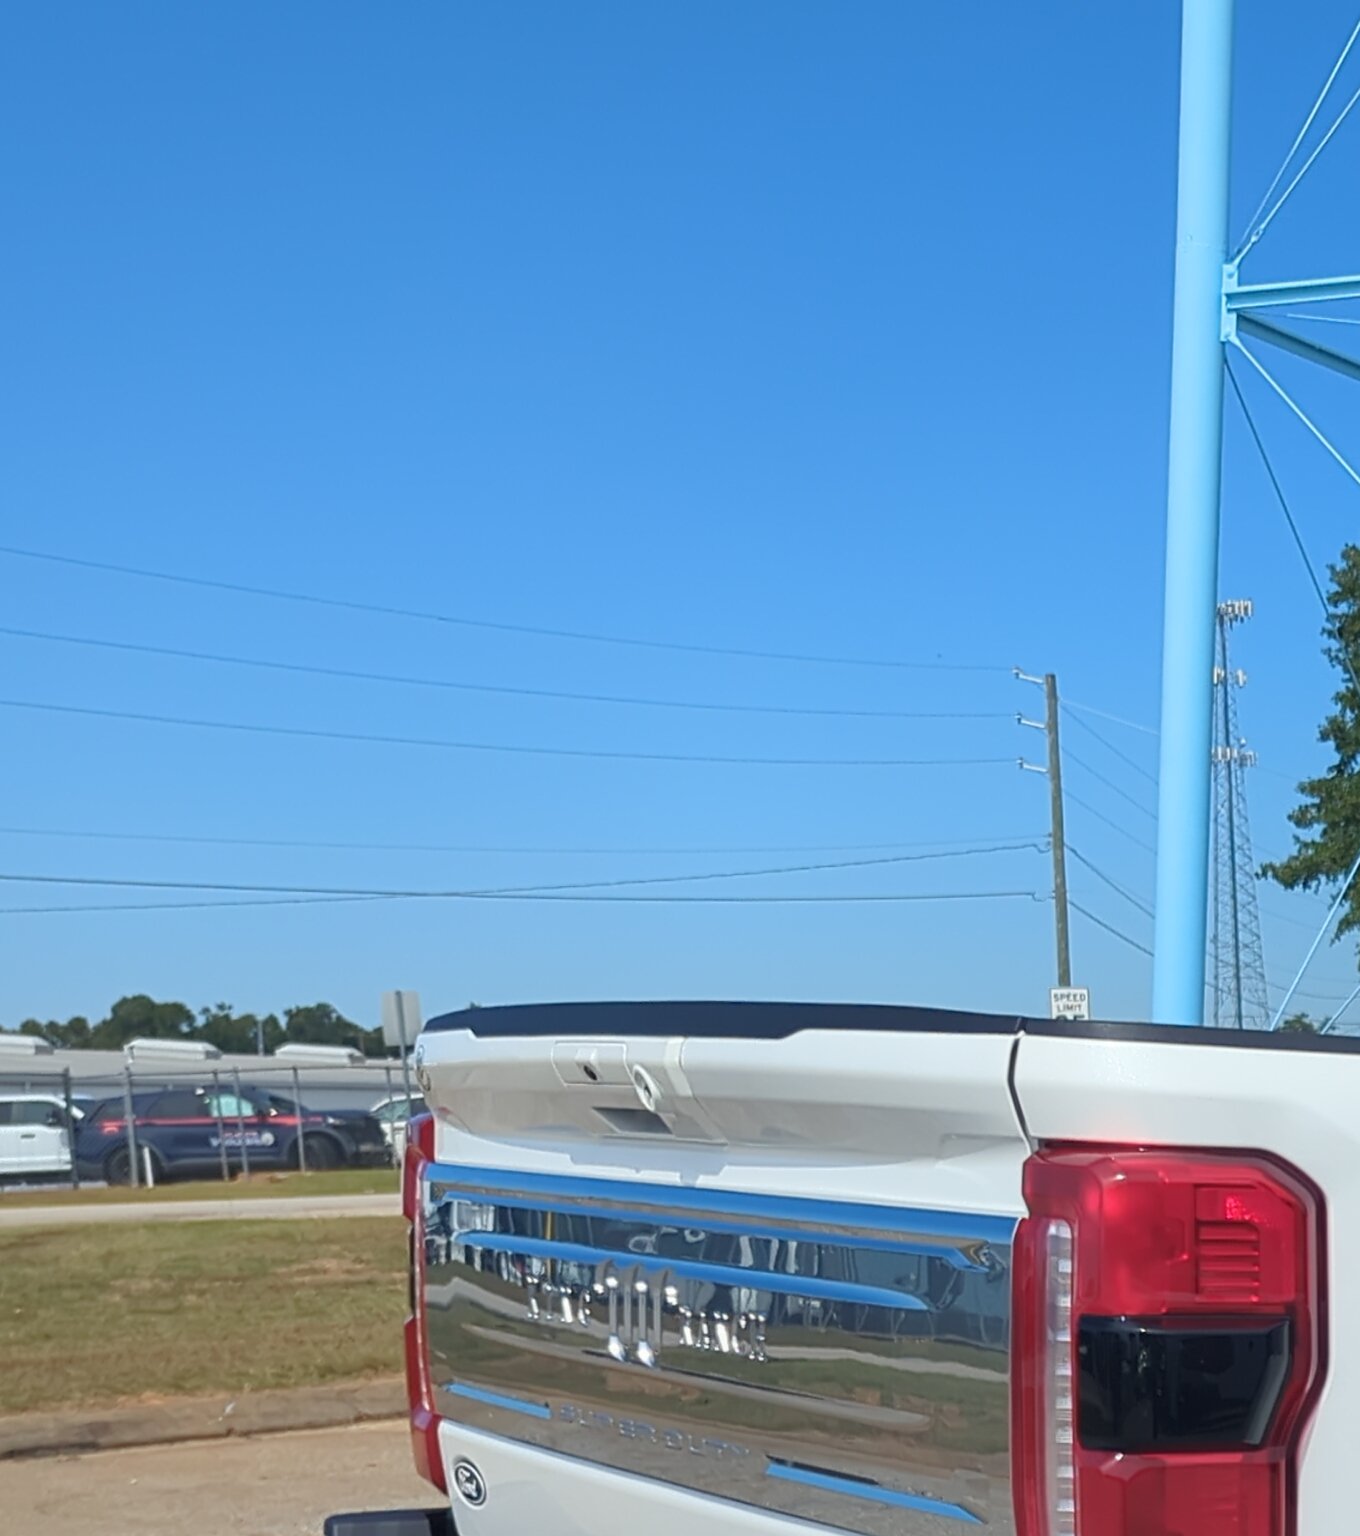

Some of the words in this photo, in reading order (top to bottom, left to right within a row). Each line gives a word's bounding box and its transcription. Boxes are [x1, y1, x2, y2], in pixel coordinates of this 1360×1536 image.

[1053, 993, 1086, 1002] SPEED
[1057, 1003, 1082, 1013] LIMIT
[560, 1403, 658, 1442] SUPER
[663, 1426, 753, 1458] DUTY
